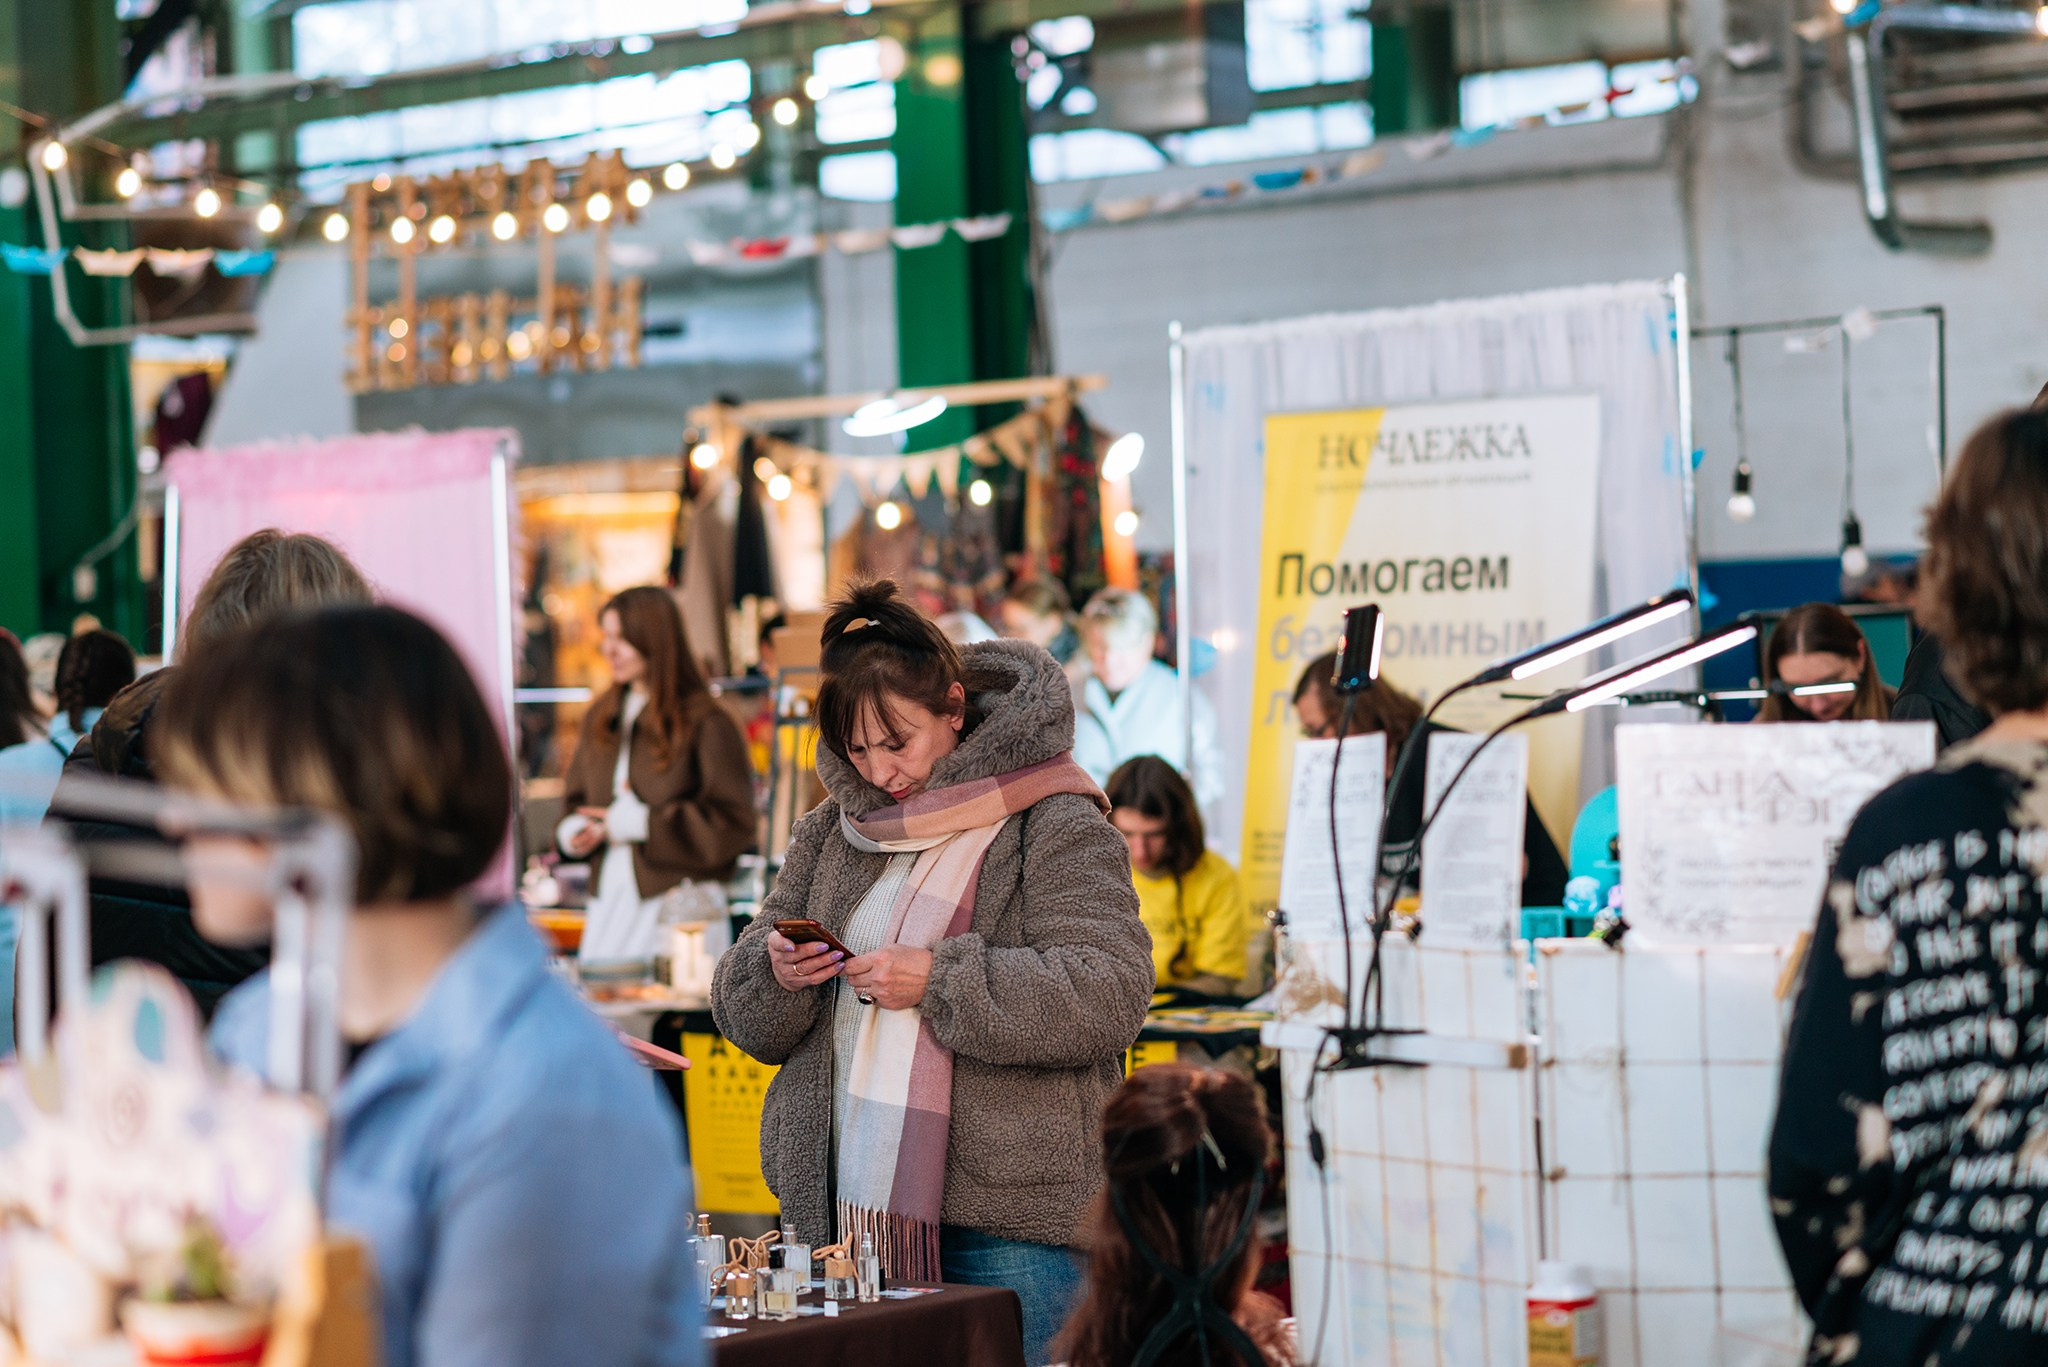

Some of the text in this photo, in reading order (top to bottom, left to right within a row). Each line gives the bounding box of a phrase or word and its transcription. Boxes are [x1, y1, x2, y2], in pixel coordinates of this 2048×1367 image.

[1317, 425, 1532, 469] НОЧЛЕЖКА
[1276, 553, 1510, 597] Помогаем
[1270, 615, 1548, 661] беомным
